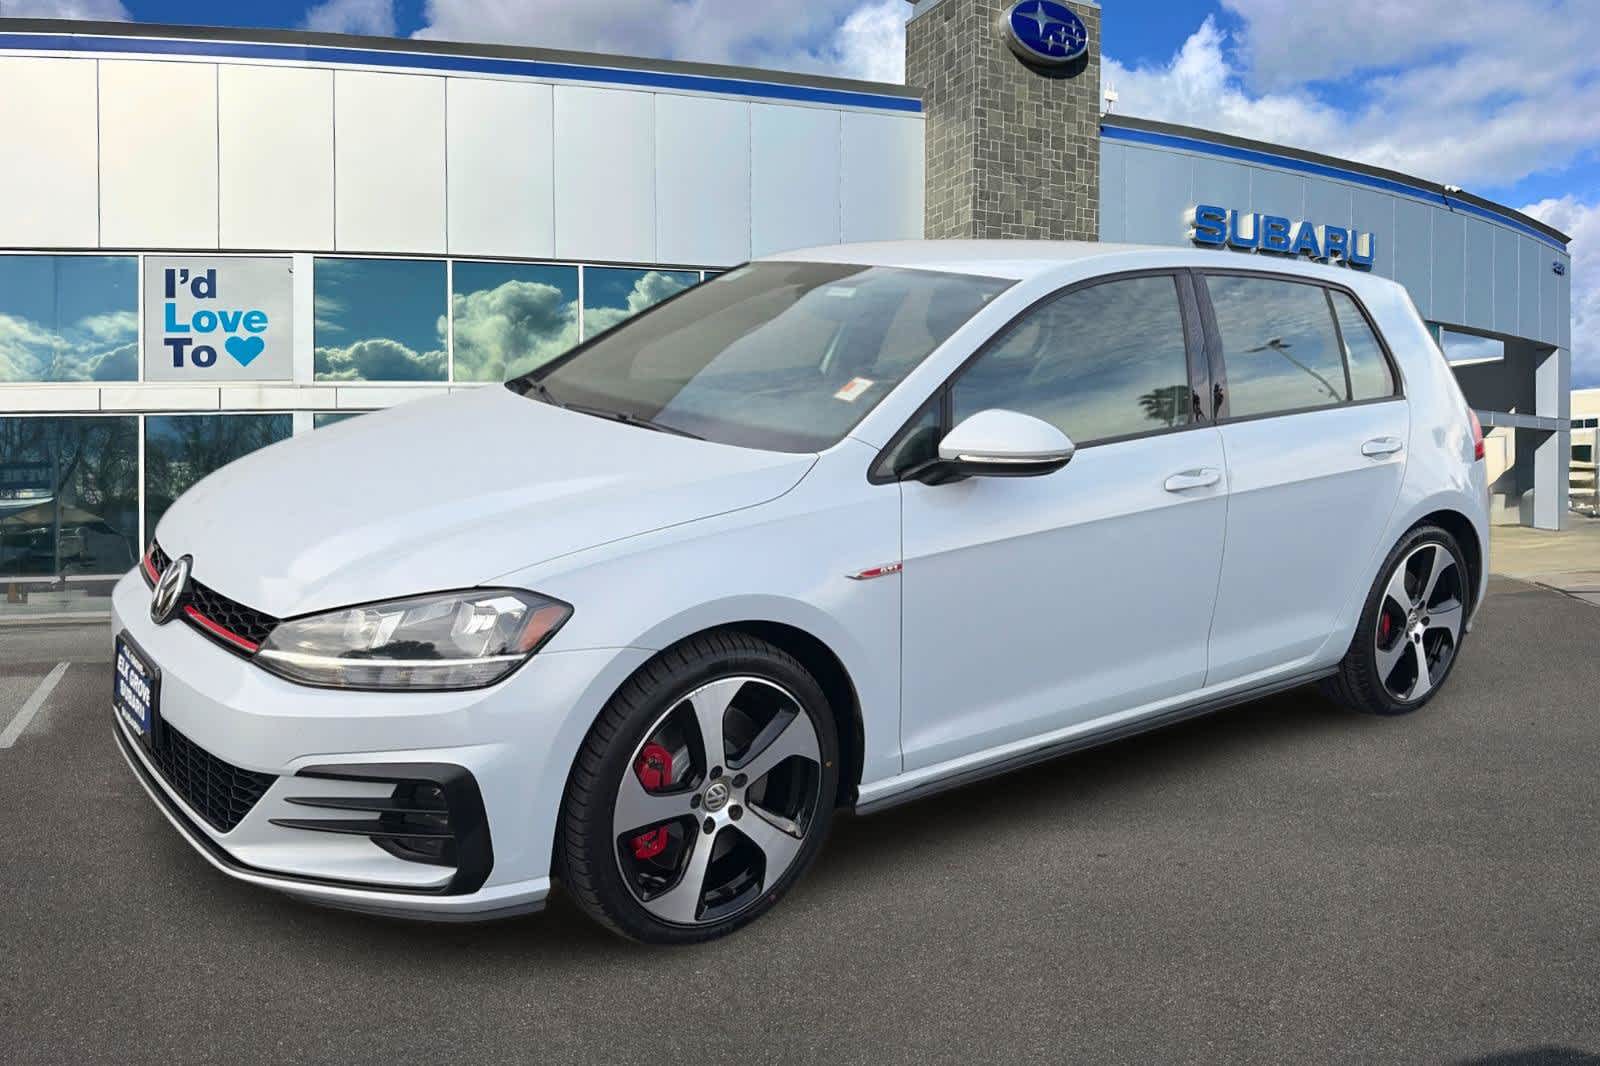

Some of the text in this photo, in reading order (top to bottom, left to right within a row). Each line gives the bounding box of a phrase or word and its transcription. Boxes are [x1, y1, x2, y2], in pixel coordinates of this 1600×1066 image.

[1192, 204, 1375, 268] SUBARU
[165, 269, 217, 299] I'd
[165, 302, 269, 333] Love
[164, 337, 217, 368] To
[116, 653, 130, 681] ELK
[128, 668, 151, 708] GROVE
